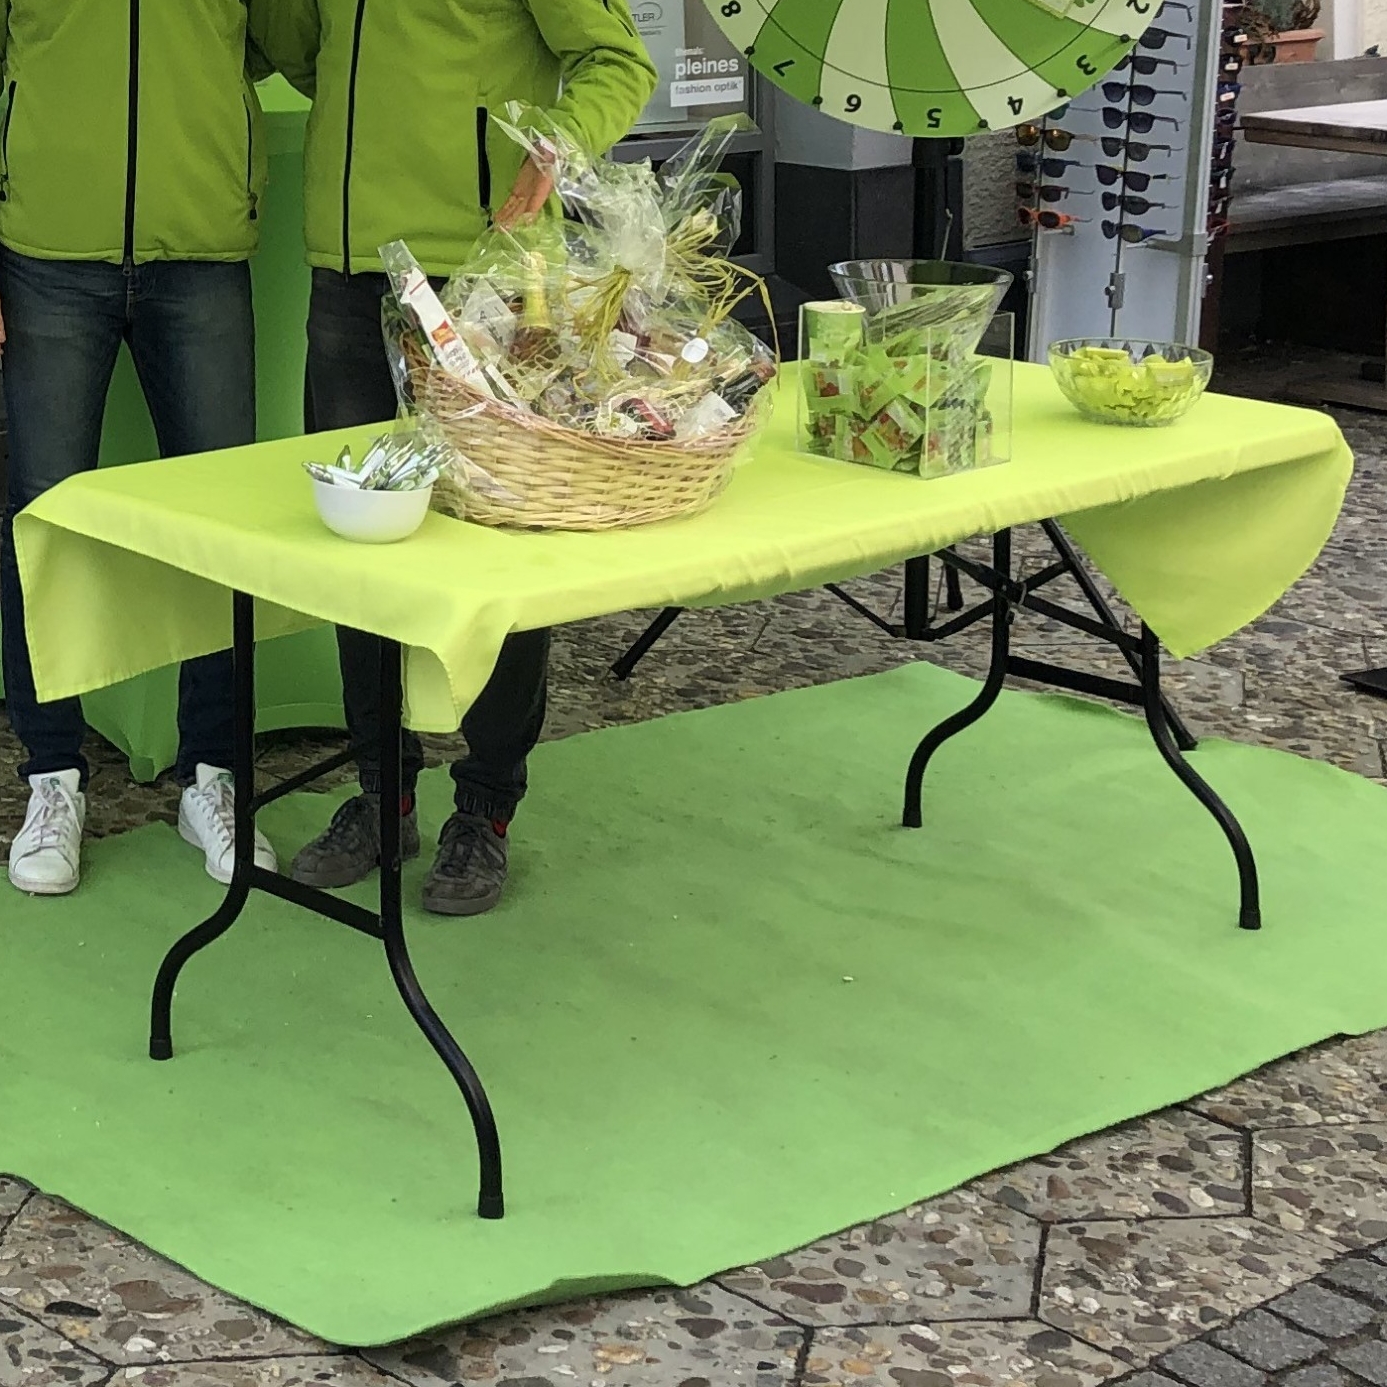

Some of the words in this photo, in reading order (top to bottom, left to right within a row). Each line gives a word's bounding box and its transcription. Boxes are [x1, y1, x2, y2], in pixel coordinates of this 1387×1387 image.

[632, 12, 655, 23] TLER
[721, 0, 742, 18] 8
[675, 57, 739, 80] pleines
[772, 59, 795, 77] 7
[1076, 54, 1097, 76] 3
[675, 84, 711, 94] fashion
[1007, 96, 1023, 116] 4
[926, 108, 942, 129] 5
